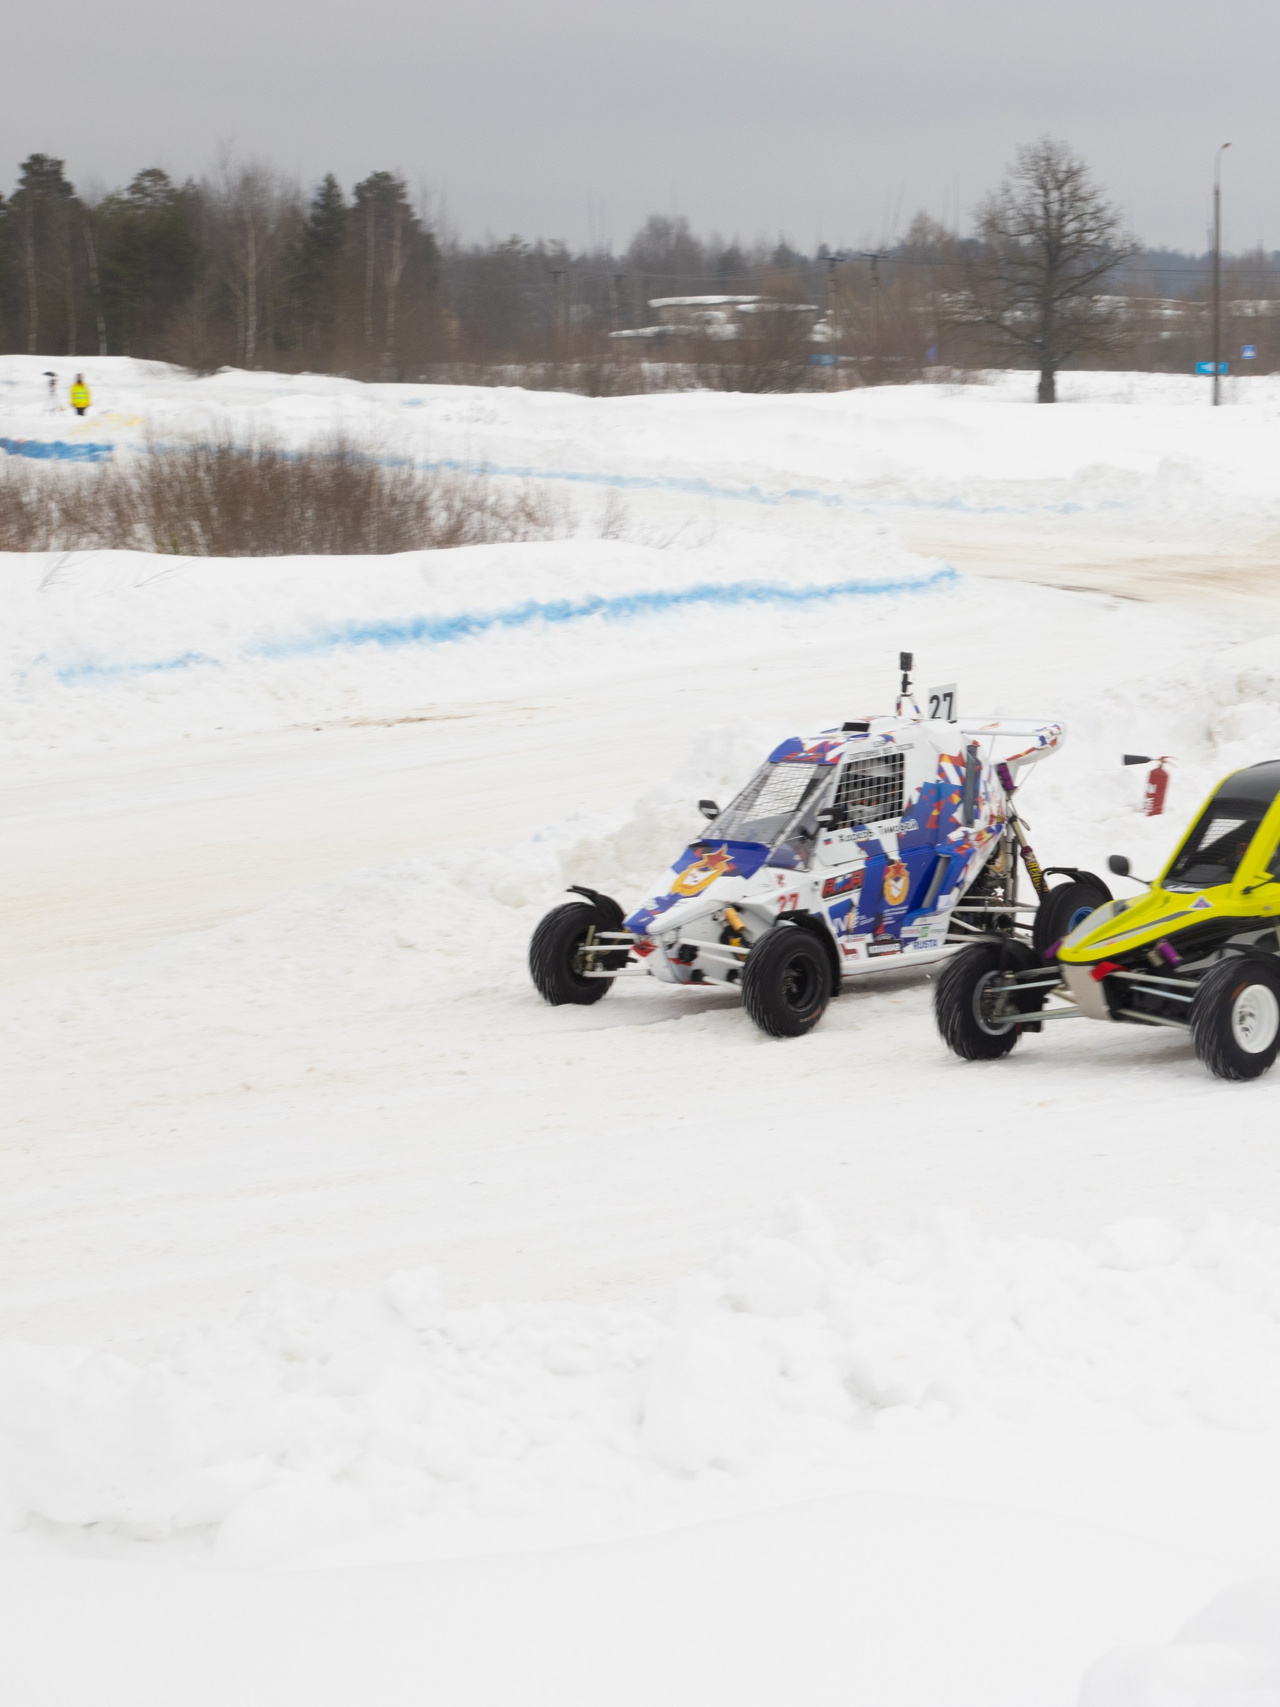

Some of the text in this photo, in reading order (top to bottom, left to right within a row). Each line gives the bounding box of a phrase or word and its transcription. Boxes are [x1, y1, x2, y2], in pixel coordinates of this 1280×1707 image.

[929, 692, 954, 720] 27
[777, 893, 799, 913] 27
[913, 939, 938, 950] RUSTA
